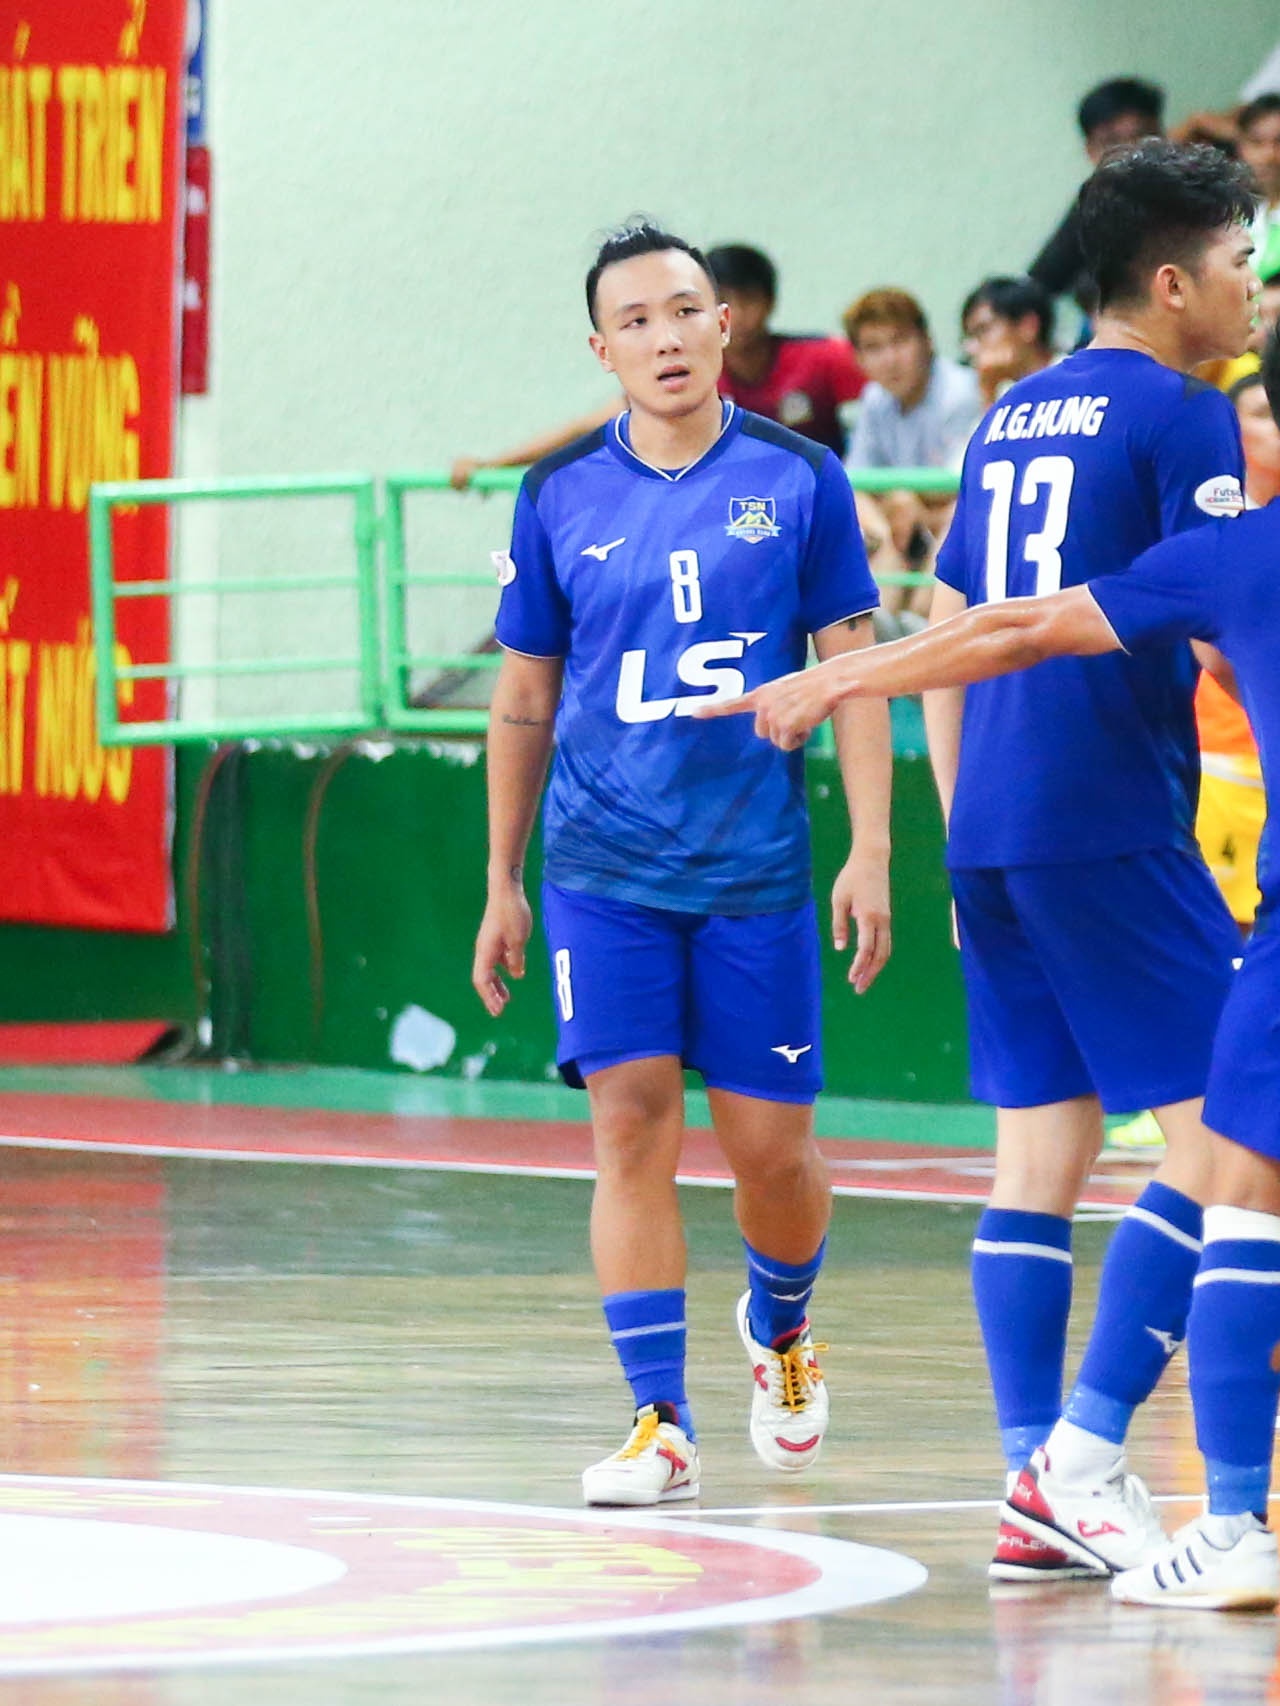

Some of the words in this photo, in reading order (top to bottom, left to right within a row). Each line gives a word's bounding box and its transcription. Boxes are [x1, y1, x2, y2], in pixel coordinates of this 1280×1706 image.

[985, 396, 1108, 445] N.G.HUNG
[739, 501, 766, 512] TSN
[981, 455, 1075, 602] 13
[669, 549, 703, 624] 8
[615, 639, 745, 725] LS
[555, 948, 574, 1022] 8
